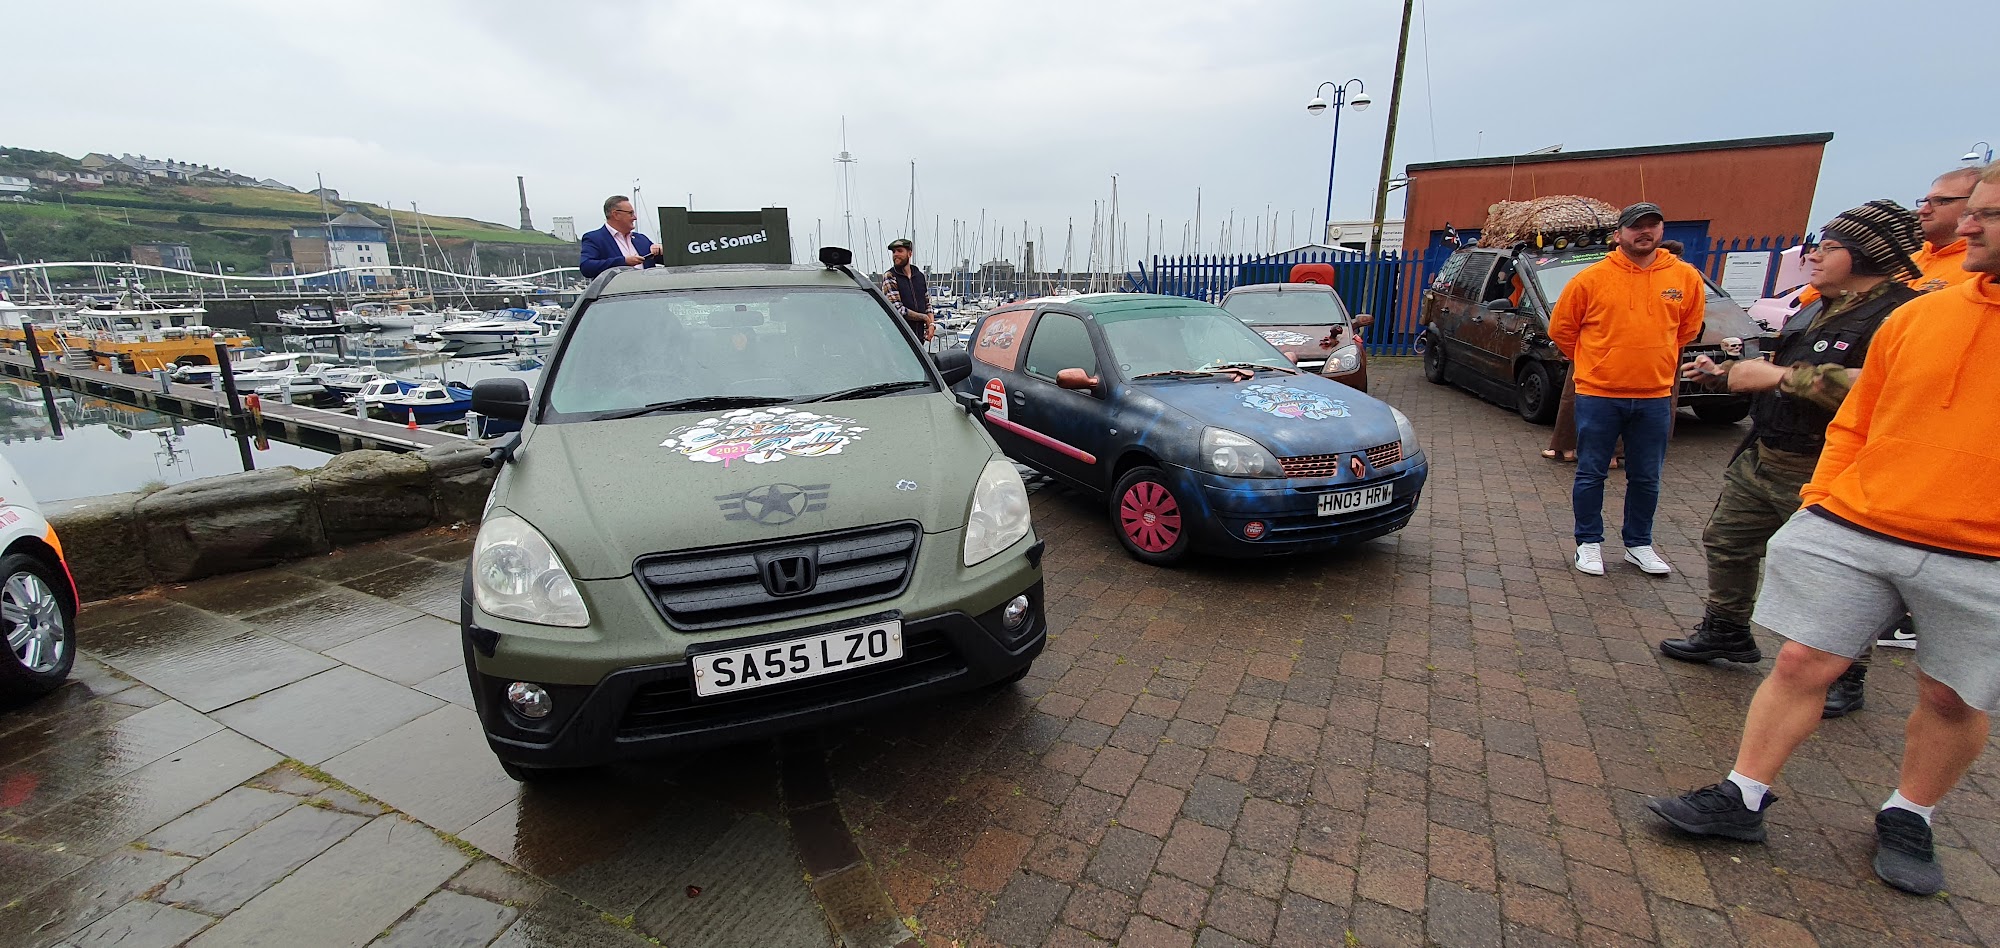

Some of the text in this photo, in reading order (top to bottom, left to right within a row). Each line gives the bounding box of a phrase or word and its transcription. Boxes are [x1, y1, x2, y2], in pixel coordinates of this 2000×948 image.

[688, 230, 767, 254] Get Some!
[716, 445, 745, 455] 2021
[1323, 486, 1389, 511] HN03 HRW
[712, 644, 810, 687] SA55
[820, 629, 888, 668] LZO
